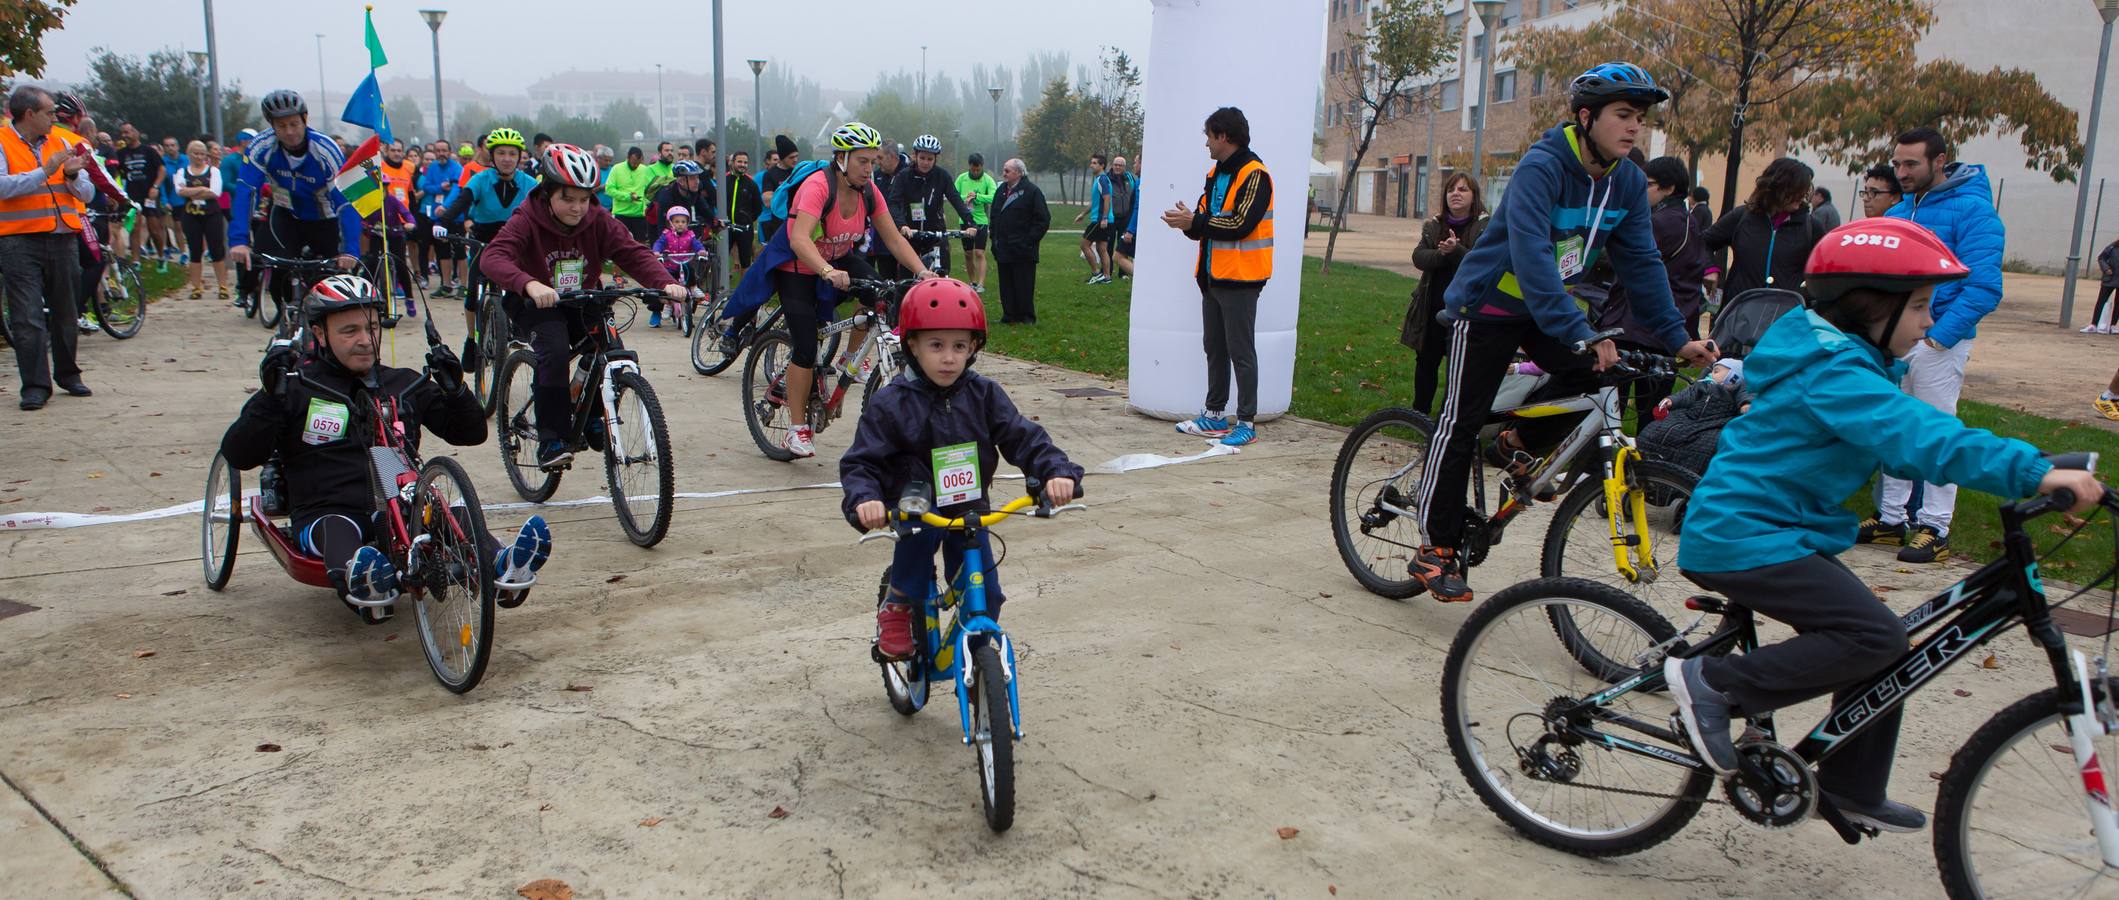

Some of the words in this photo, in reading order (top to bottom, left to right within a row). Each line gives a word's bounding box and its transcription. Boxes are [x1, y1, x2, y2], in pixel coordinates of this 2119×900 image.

[1561, 253, 1578, 269] 0571
[560, 276, 578, 285] 0578
[313, 418, 341, 433] 0579
[943, 470, 974, 489] 0062
